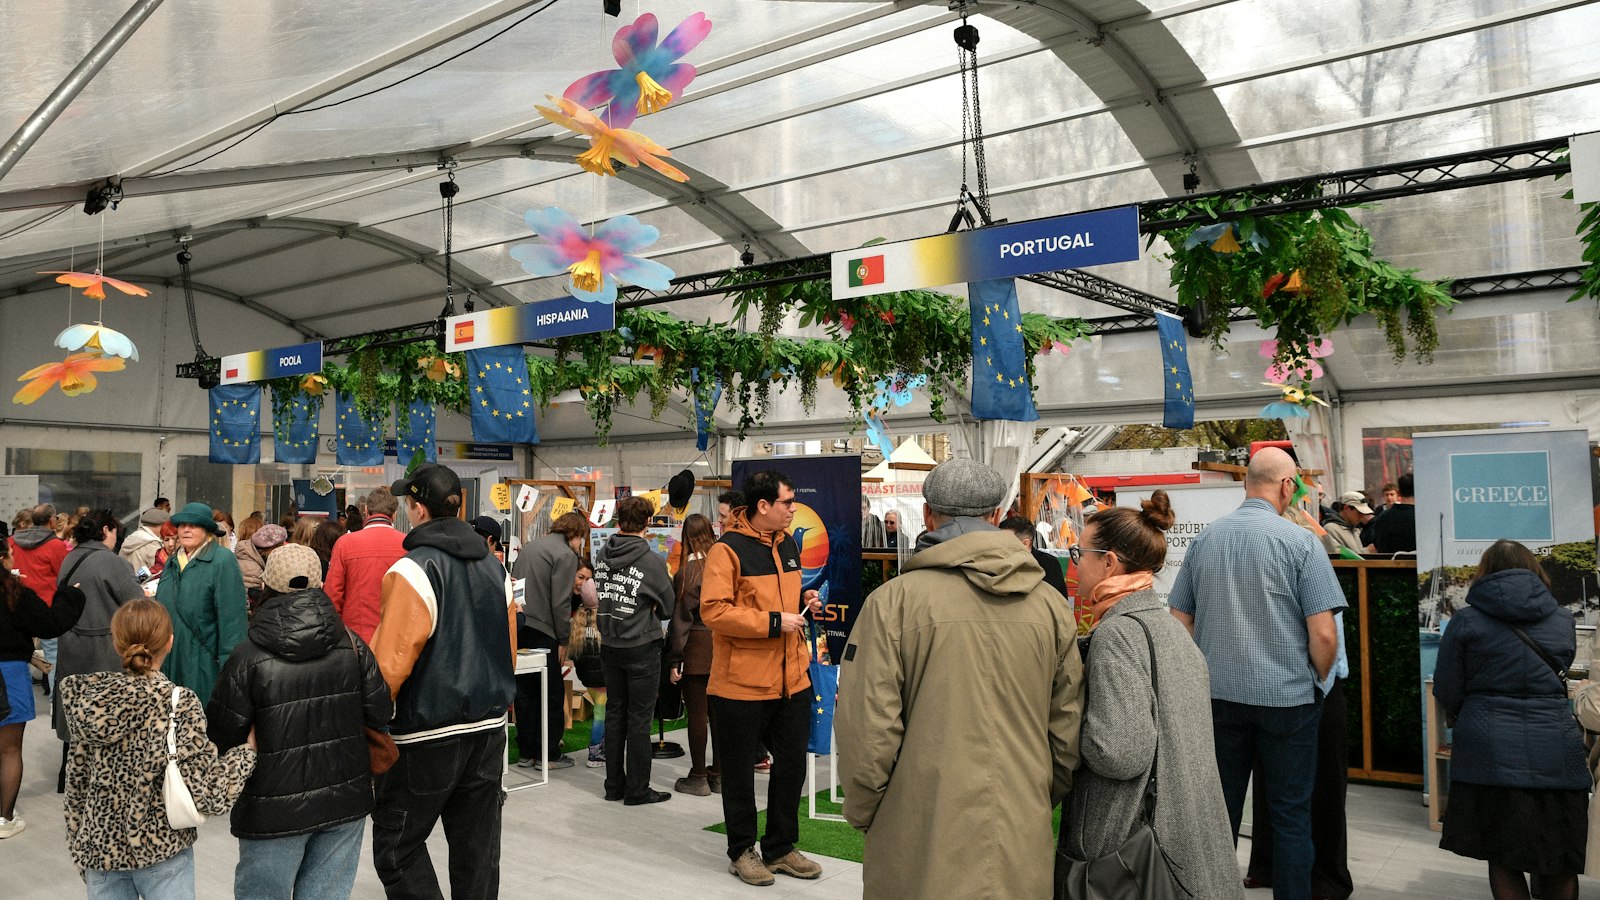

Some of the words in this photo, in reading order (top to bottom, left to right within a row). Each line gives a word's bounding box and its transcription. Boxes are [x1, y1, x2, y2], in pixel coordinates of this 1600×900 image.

[1000, 232, 1094, 258] PORTUGAL
[536, 308, 589, 326] HISPAANIA
[279, 355, 302, 367] POOLA
[1455, 485, 1548, 503] GREECE
[1166, 536, 1193, 548] PORT
[1166, 558, 1183, 567] NEGÓ
[629, 566, 644, 579] the
[612, 572, 641, 589] slaying
[603, 582, 627, 594] game,
[631, 586, 637, 597] &
[619, 595, 638, 606] real.
[812, 603, 849, 622] EST
[827, 630, 846, 638] STIVAL
